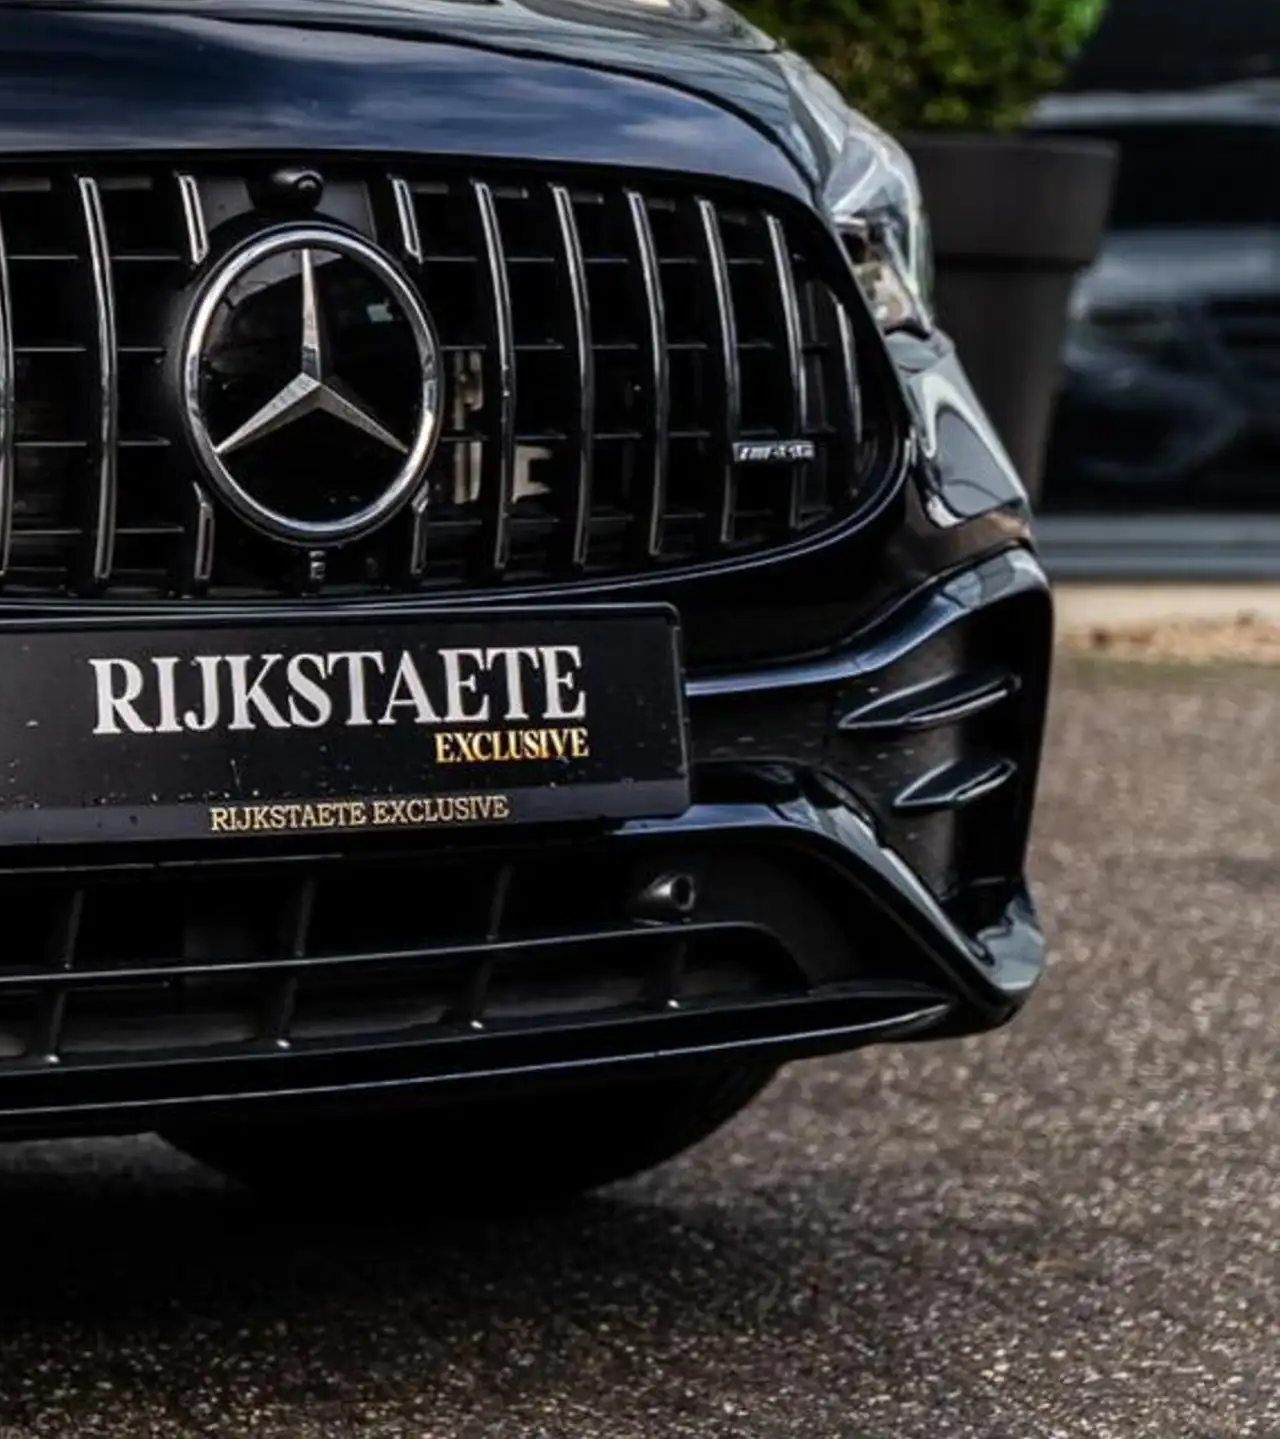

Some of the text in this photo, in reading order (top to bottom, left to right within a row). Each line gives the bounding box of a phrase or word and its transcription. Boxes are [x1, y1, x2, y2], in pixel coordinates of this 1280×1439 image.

[90, 646, 587, 735] RIJKSTAETE
[434, 728, 589, 764] EXCLUSIVE
[210, 796, 510, 832] RIJKSTAETE EXCLUSIVE
